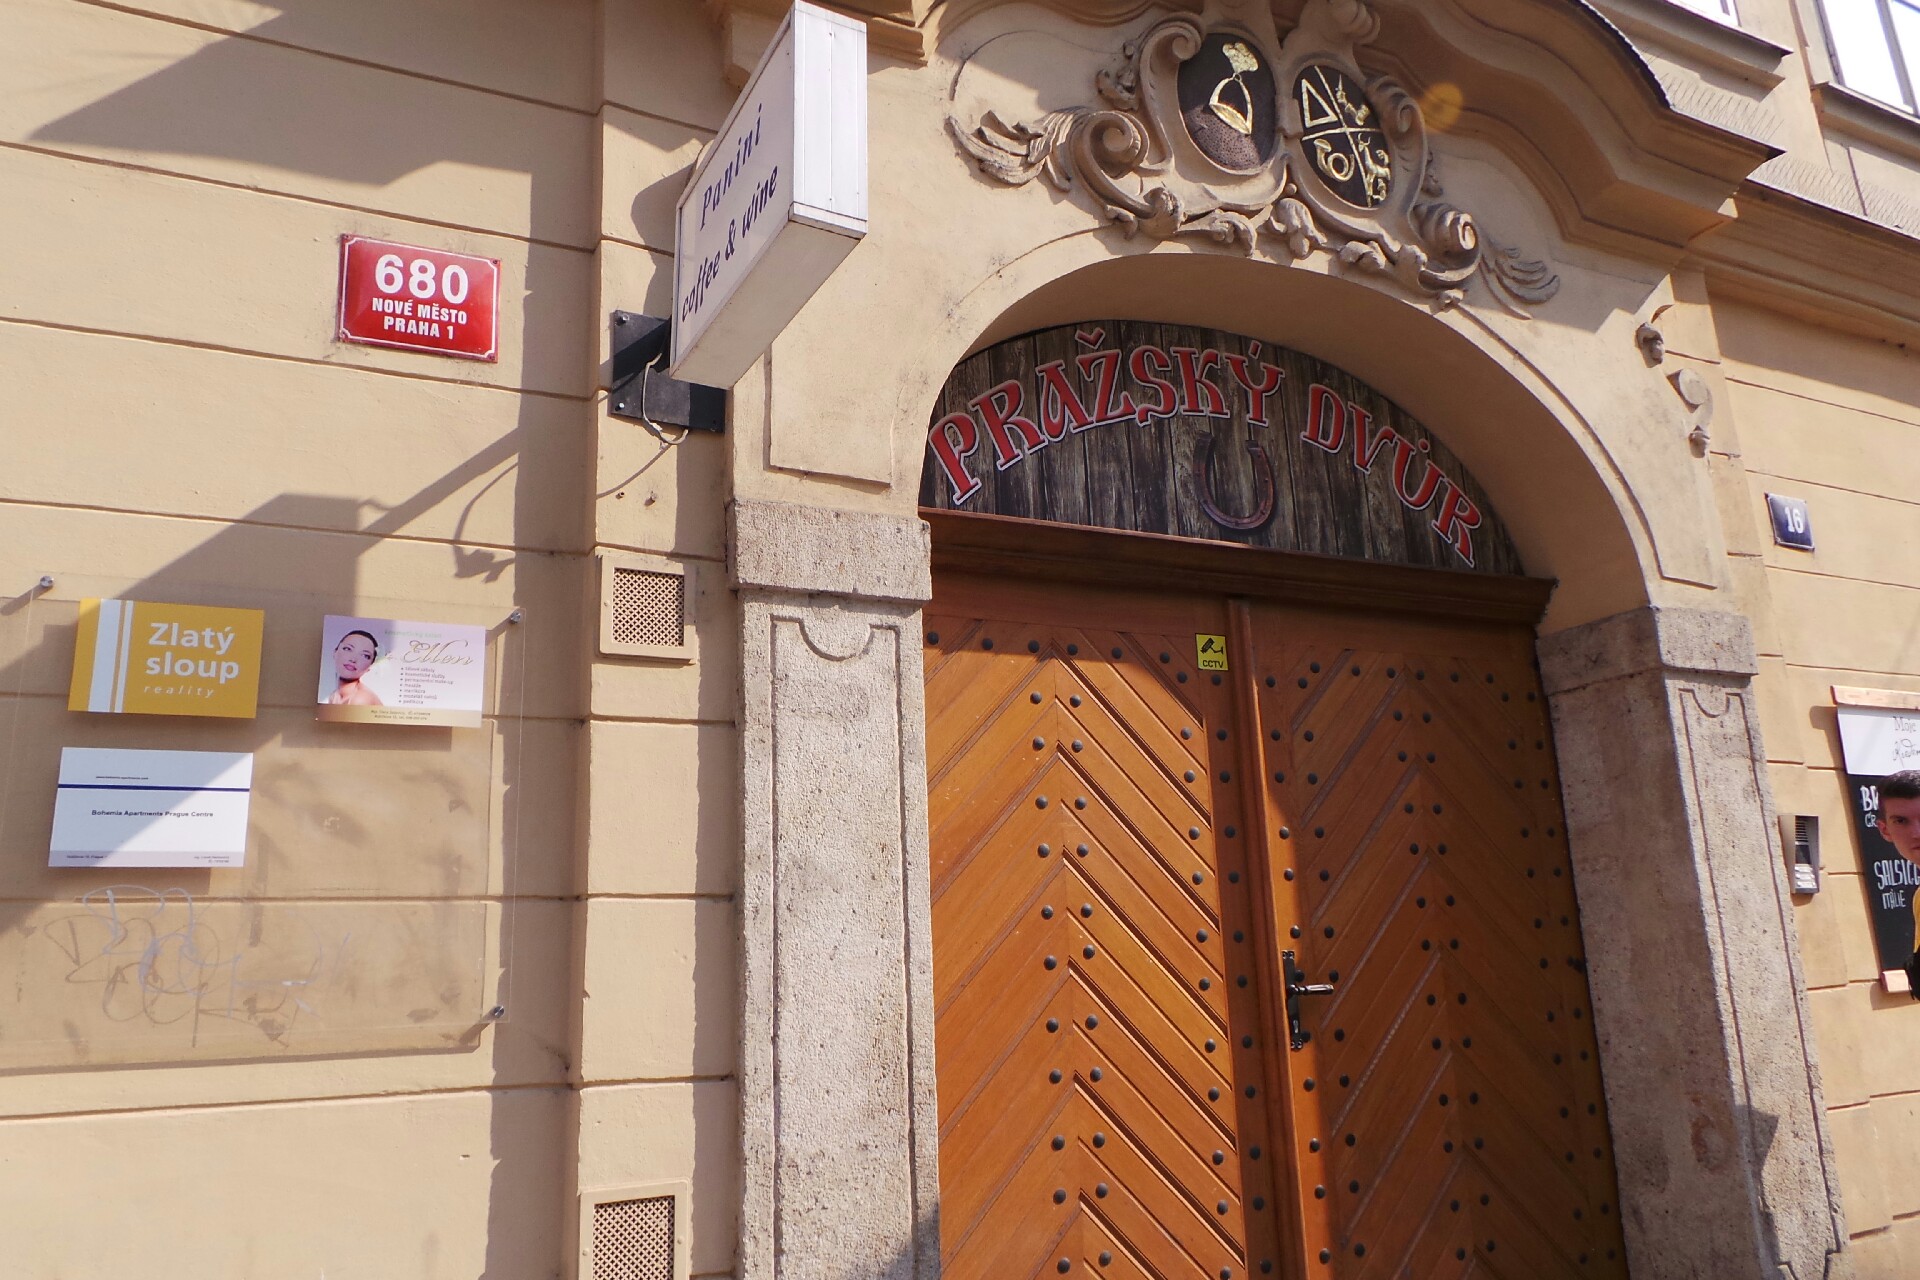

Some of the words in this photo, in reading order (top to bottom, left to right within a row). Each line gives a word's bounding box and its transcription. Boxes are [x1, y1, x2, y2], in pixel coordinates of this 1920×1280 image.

[699, 102, 763, 232] Panini
[681, 250, 721, 323] coffee
[724, 218, 737, 261] &
[741, 165, 779, 239] wine
[375, 254, 468, 304] 680
[372, 297, 413, 316] NOVÉ
[417, 302, 468, 325] MĚSTO
[383, 316, 440, 338] PRAHA
[446, 325, 455, 340] 1
[928, 327, 1285, 506] PRAŽSKÝ
[1784, 506, 1805, 534] 16
[148, 621, 236, 656] Zlatý
[145, 651, 240, 685] sloup
[1202, 659, 1224, 669] CCTV
[143, 685, 215, 699] reality
